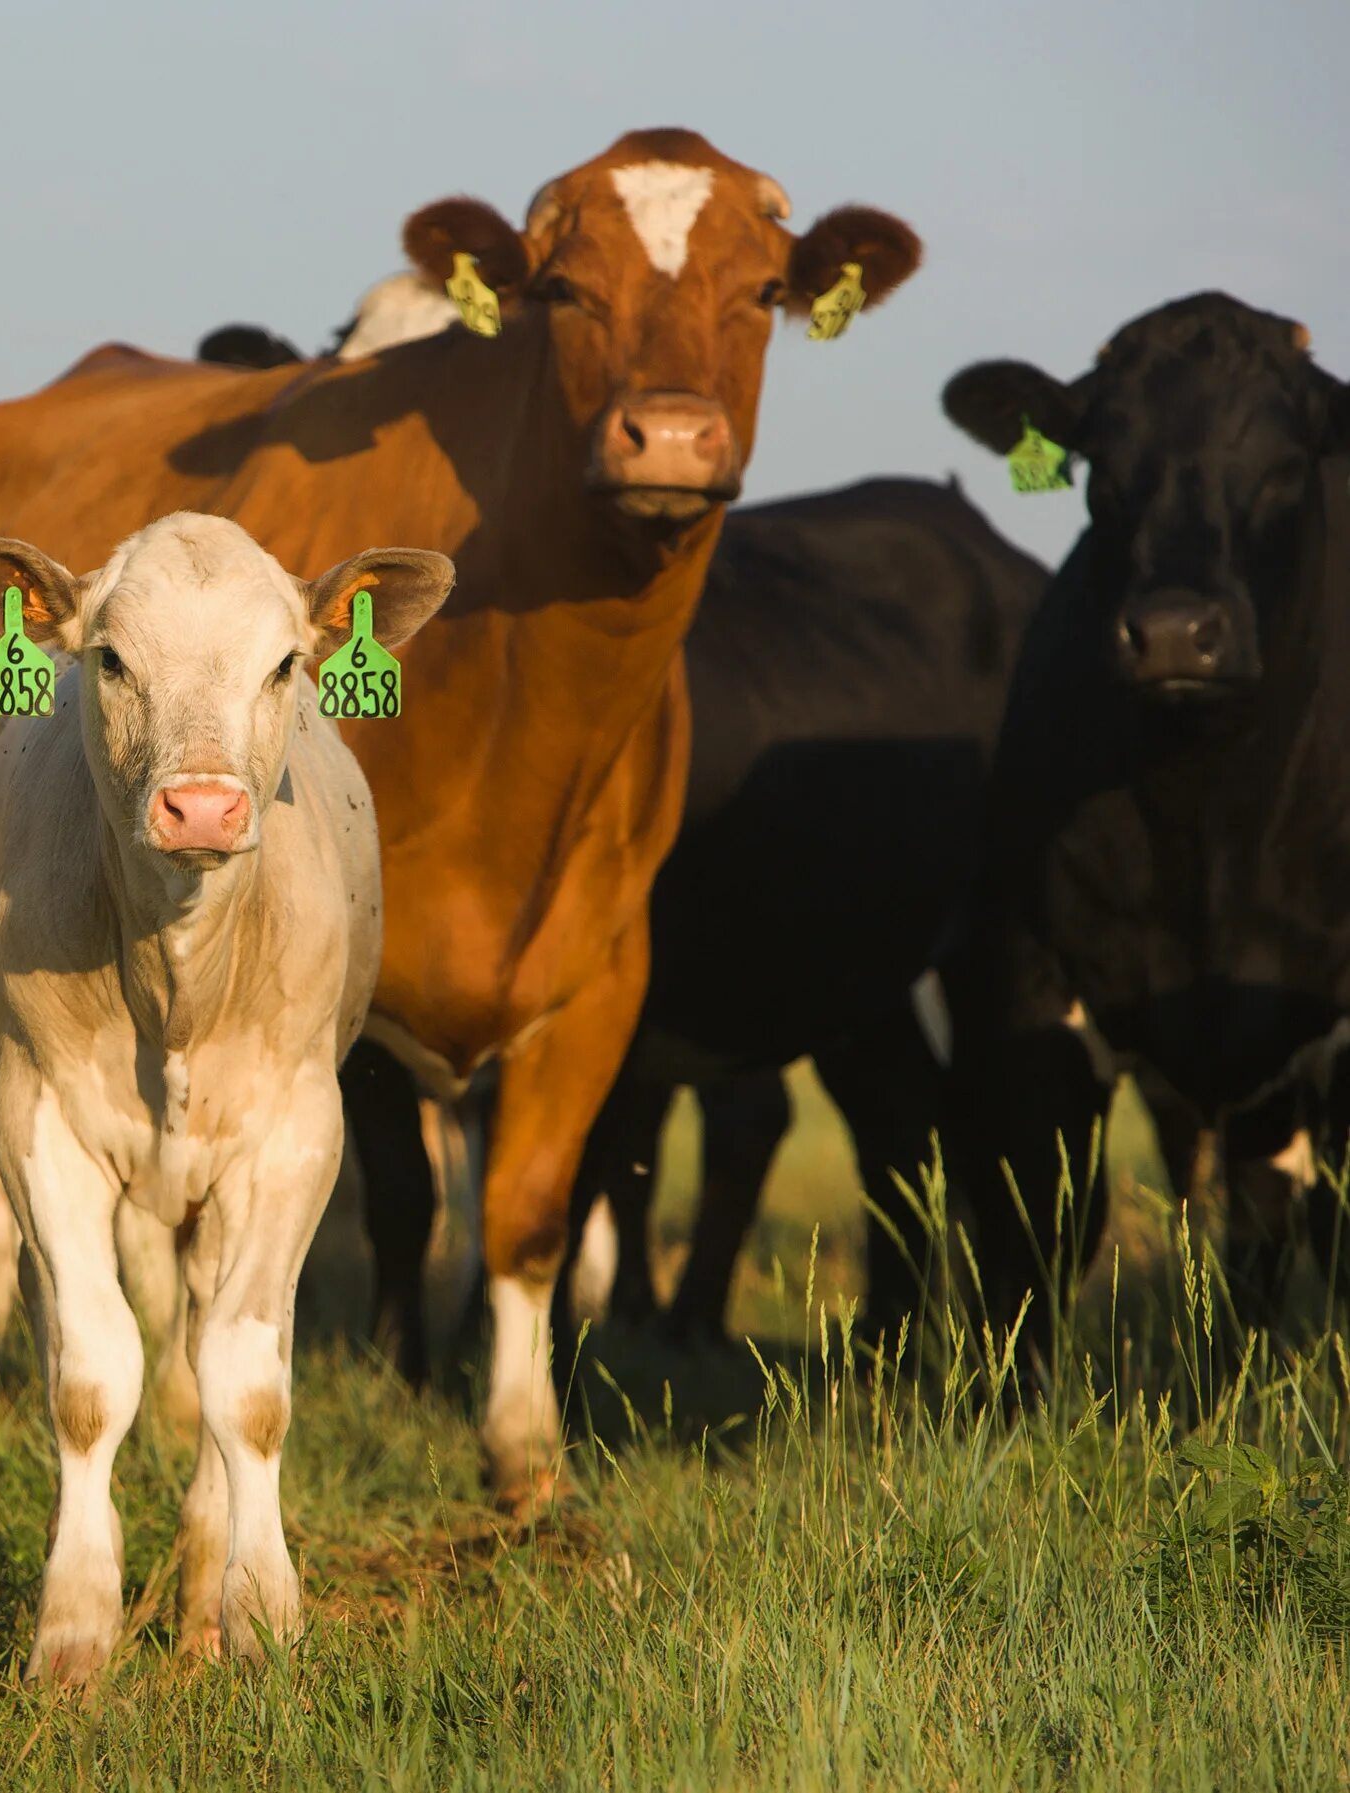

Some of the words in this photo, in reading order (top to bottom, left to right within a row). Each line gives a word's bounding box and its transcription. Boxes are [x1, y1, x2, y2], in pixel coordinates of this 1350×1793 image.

[7, 633, 24, 664] 6
[351, 636, 367, 668] 6
[319, 669, 398, 718] 8858
